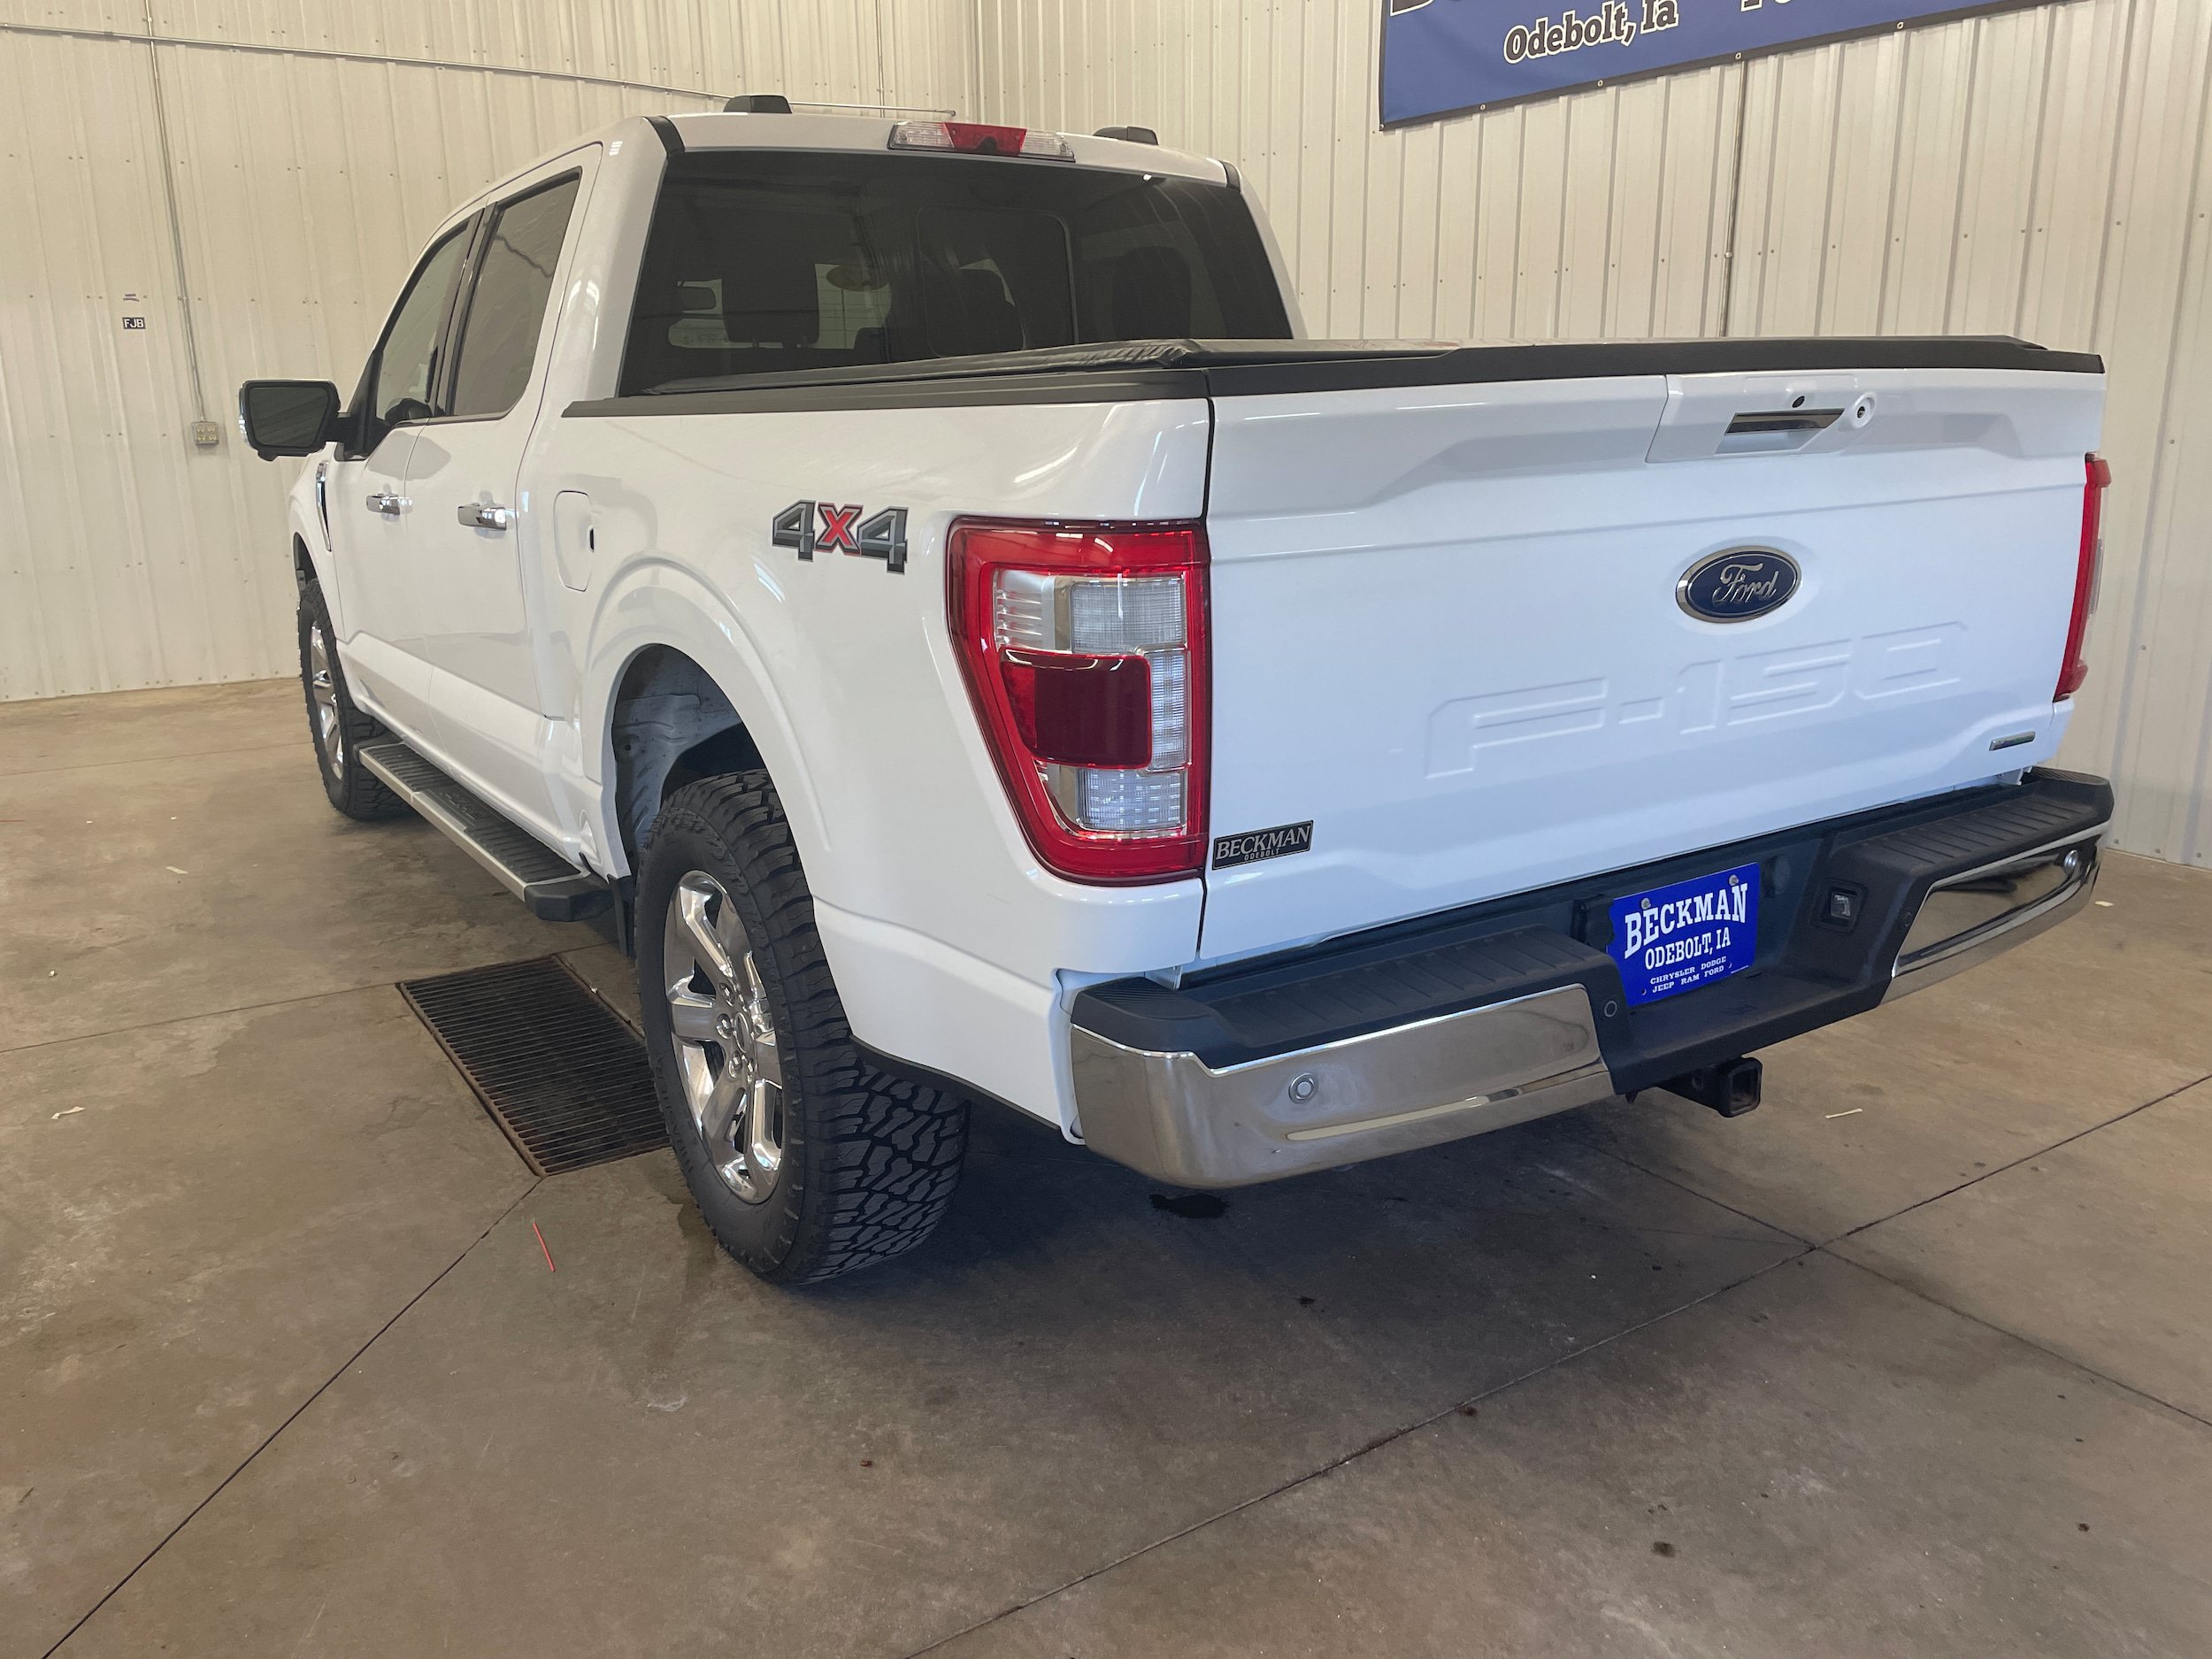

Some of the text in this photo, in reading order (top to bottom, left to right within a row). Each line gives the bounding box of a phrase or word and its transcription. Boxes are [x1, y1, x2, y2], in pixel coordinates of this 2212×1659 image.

[1504, 1, 1635, 63] Odebolt,
[123, 319, 144, 328] FJB
[1712, 563, 1779, 603] Ford
[1425, 621, 1968, 779] F-150
[1216, 826, 1310, 860] BECKMAN
[1244, 849, 1279, 861] ODEBOLT
[1624, 883, 1747, 959] BECKMAN
[1645, 926, 1732, 970] ODEBOLT, IA
[1650, 956, 1726, 985] CHRYSLER DODGE
[1652, 965, 1724, 993] JEEP RAM FORD
